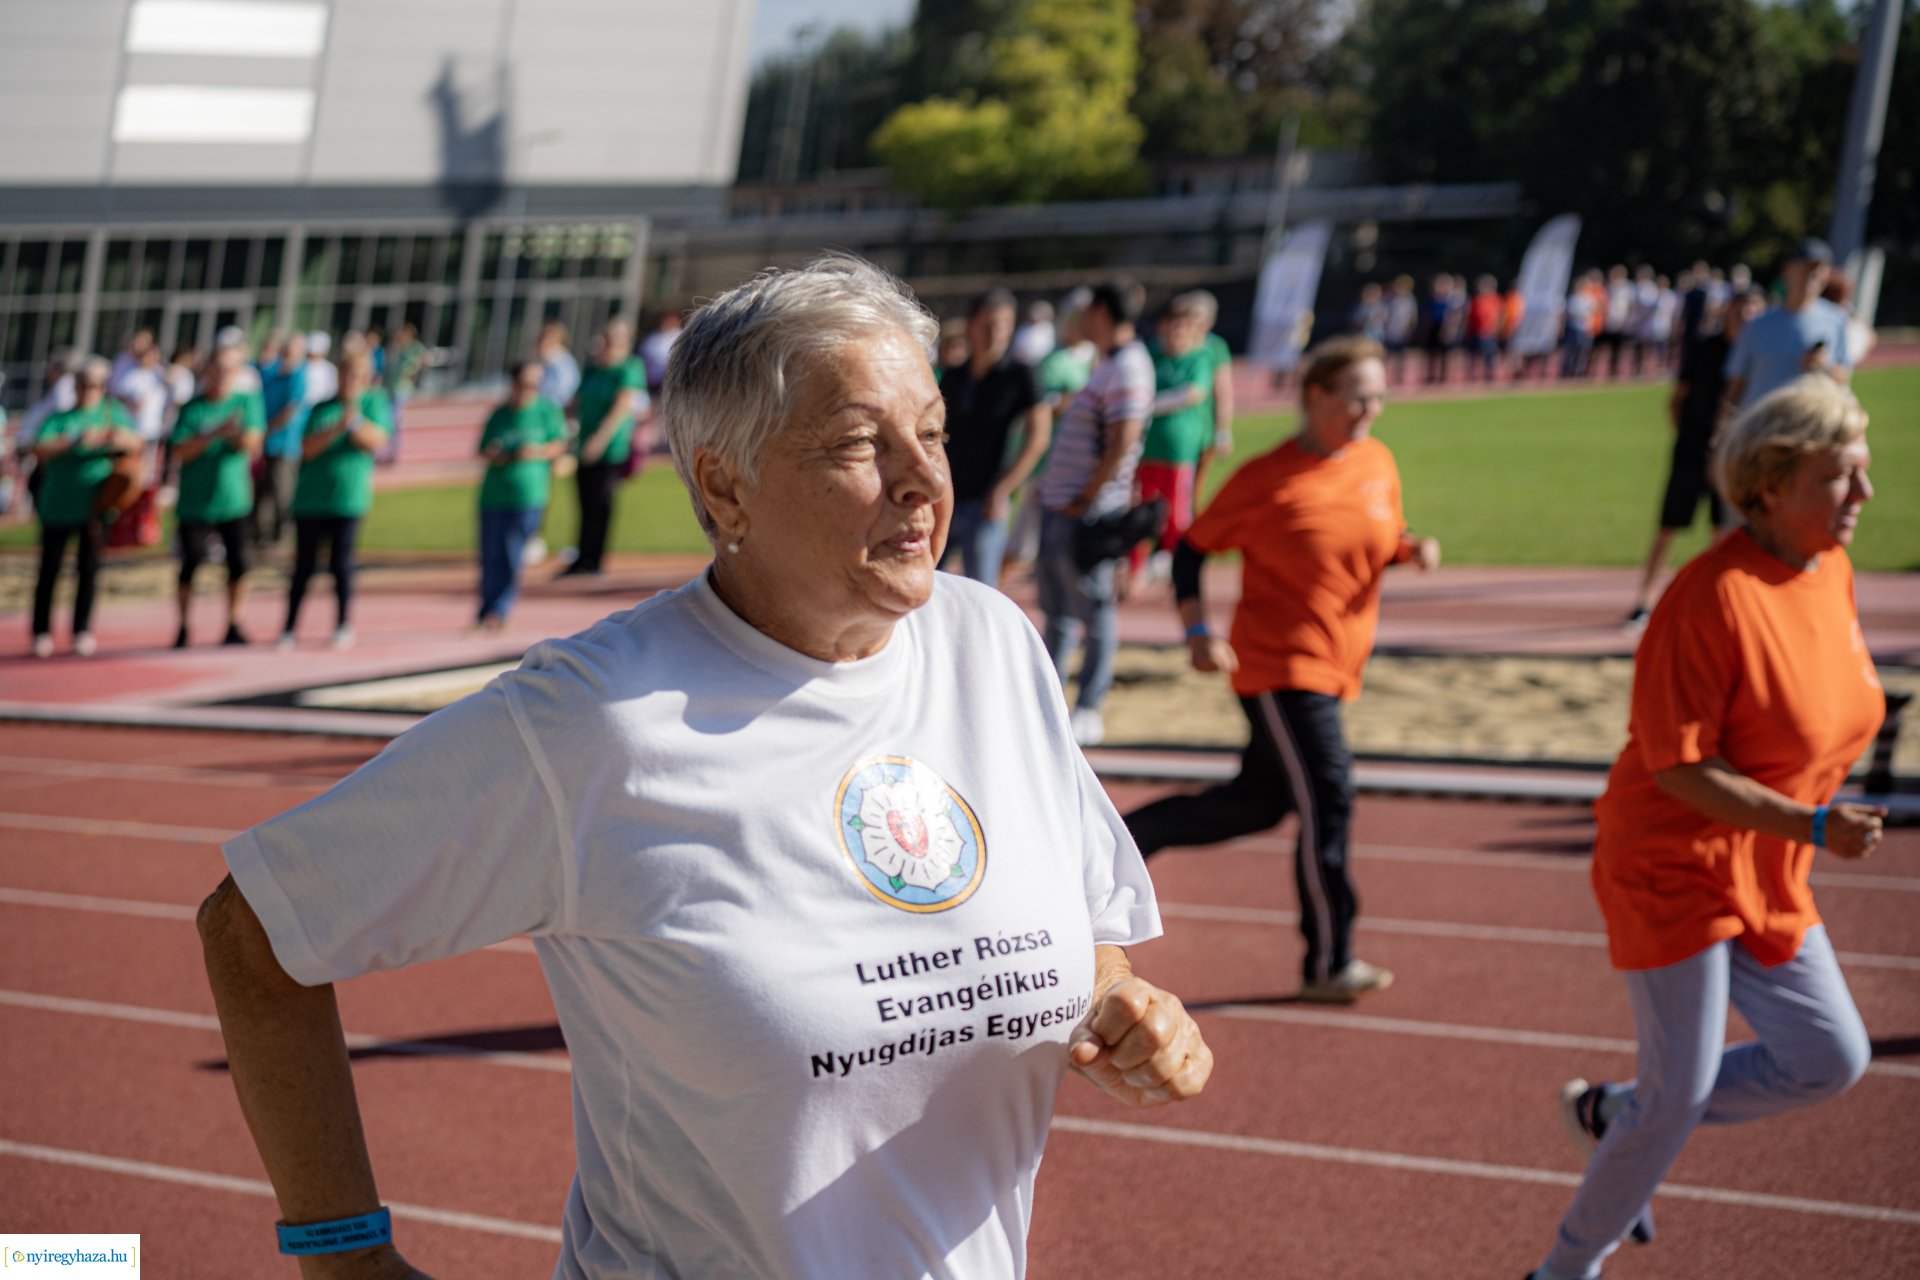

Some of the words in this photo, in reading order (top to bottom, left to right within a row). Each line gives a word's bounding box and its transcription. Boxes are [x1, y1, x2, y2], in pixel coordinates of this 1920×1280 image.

[856, 947, 963, 985] Luther
[974, 929, 1053, 961] Rózsa
[876, 968, 1060, 1023] Evangélikus
[810, 1025, 975, 1078] Nyugdíjas
